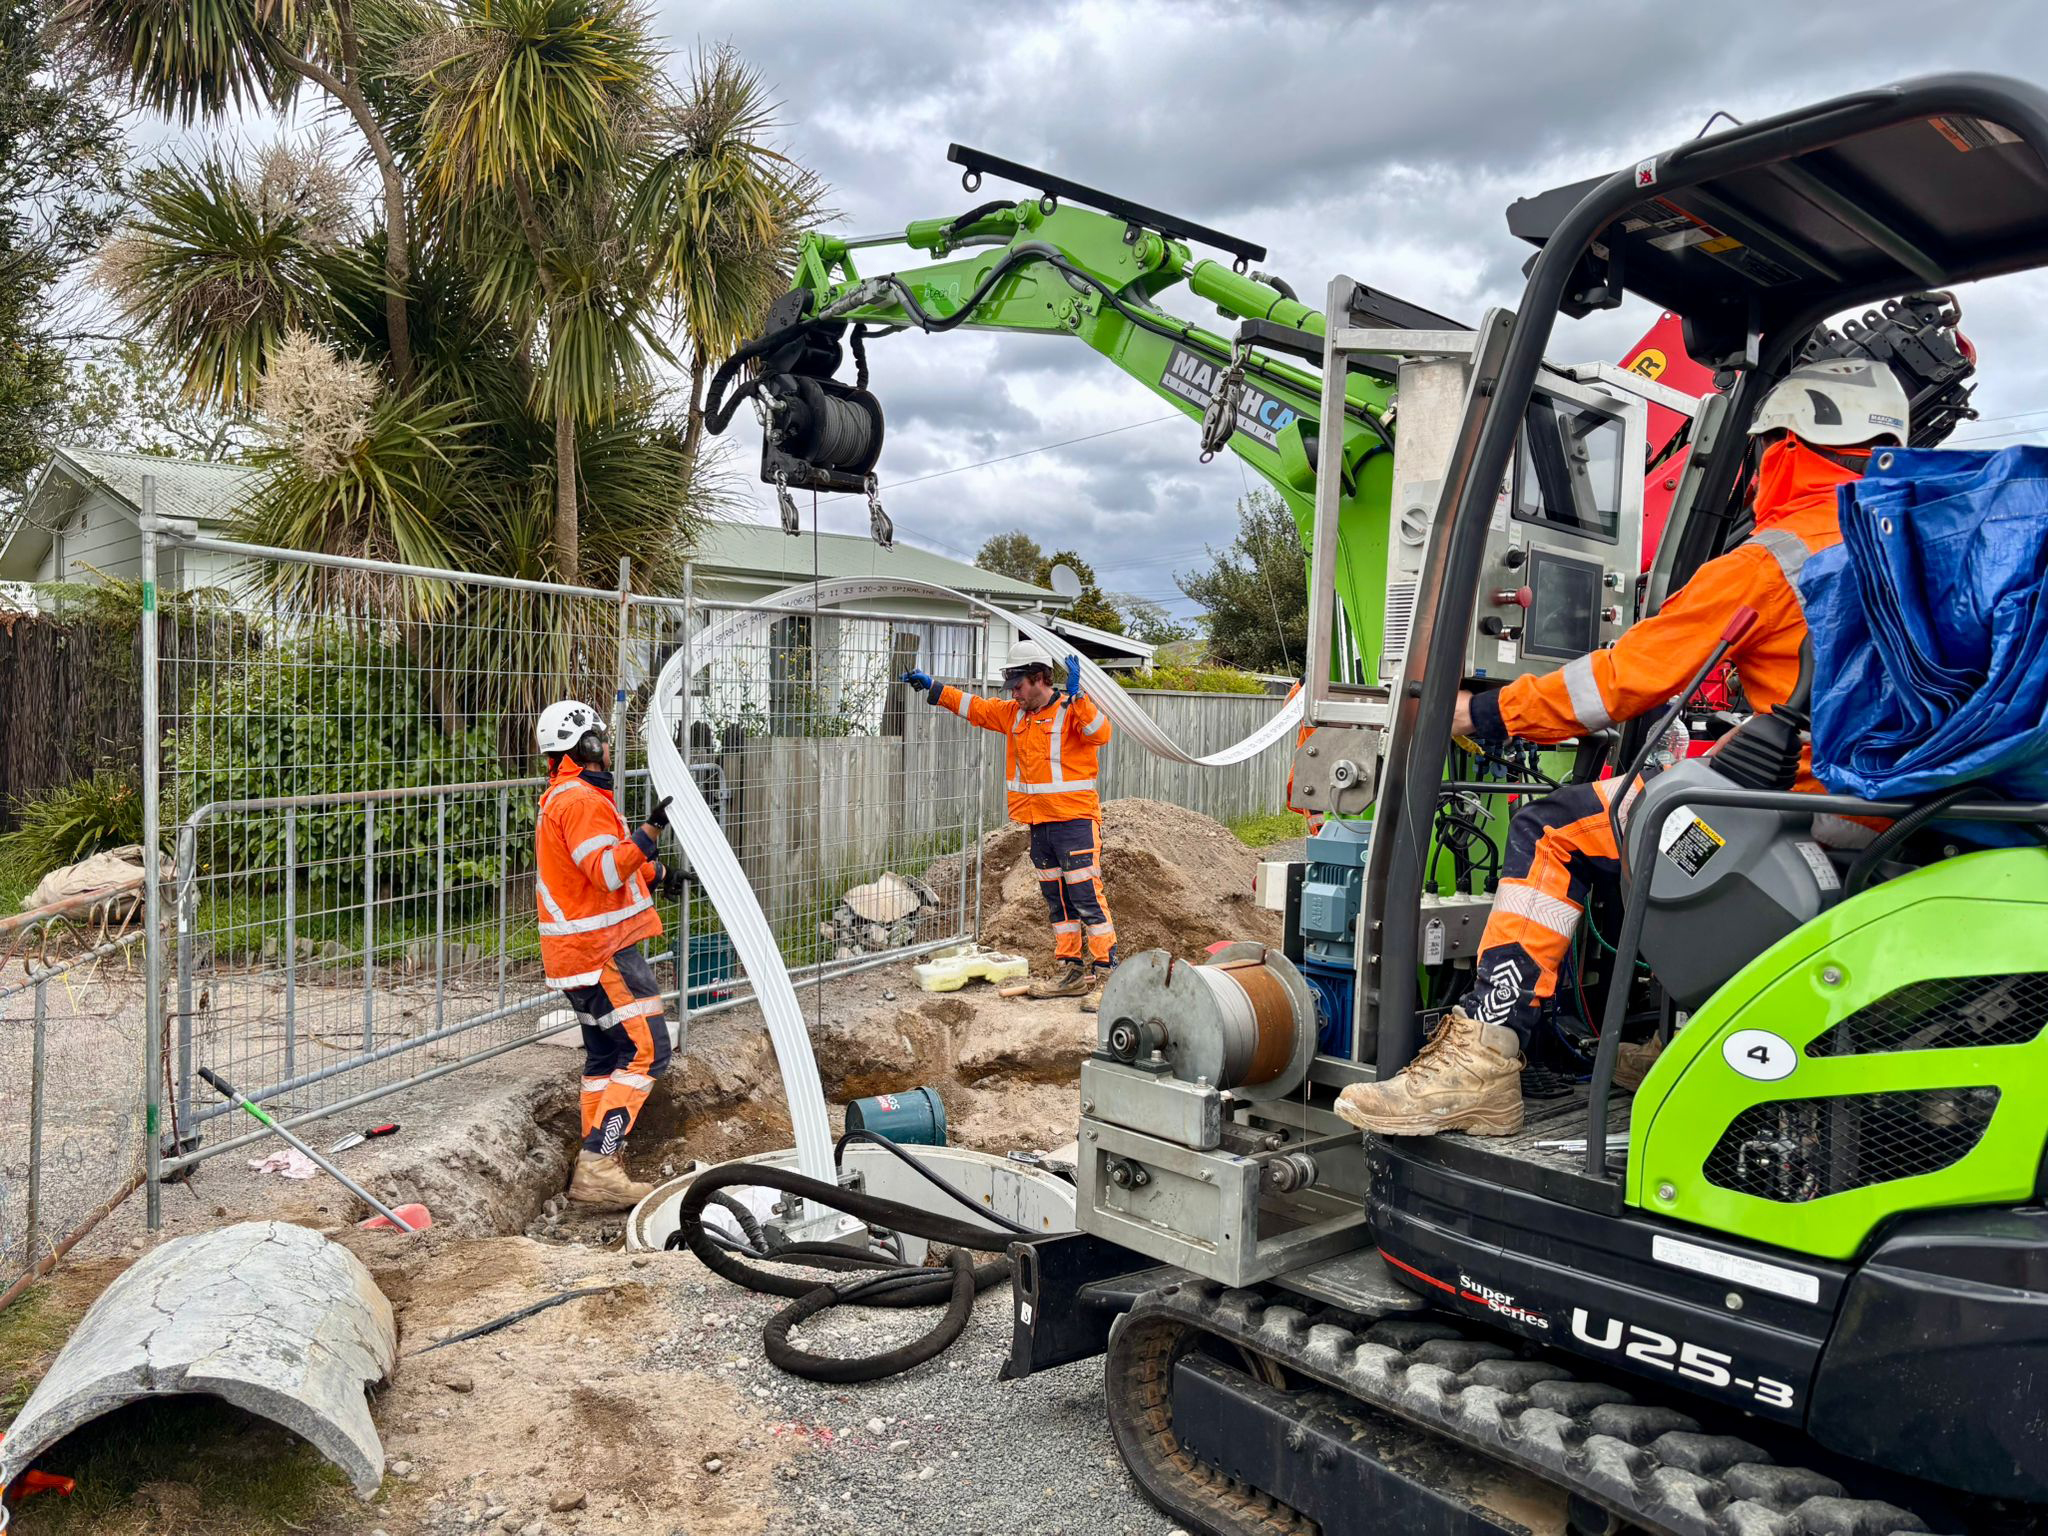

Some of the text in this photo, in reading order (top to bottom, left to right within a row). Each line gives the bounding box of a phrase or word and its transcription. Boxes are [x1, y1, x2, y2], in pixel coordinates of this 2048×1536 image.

[1171, 351, 1297, 430] MAHCA
[1746, 1045, 1770, 1065] 4
[1459, 1274, 1515, 1307] Super
[1488, 1298, 1549, 1329] Series
[1571, 1306, 1794, 1410] U25-3
